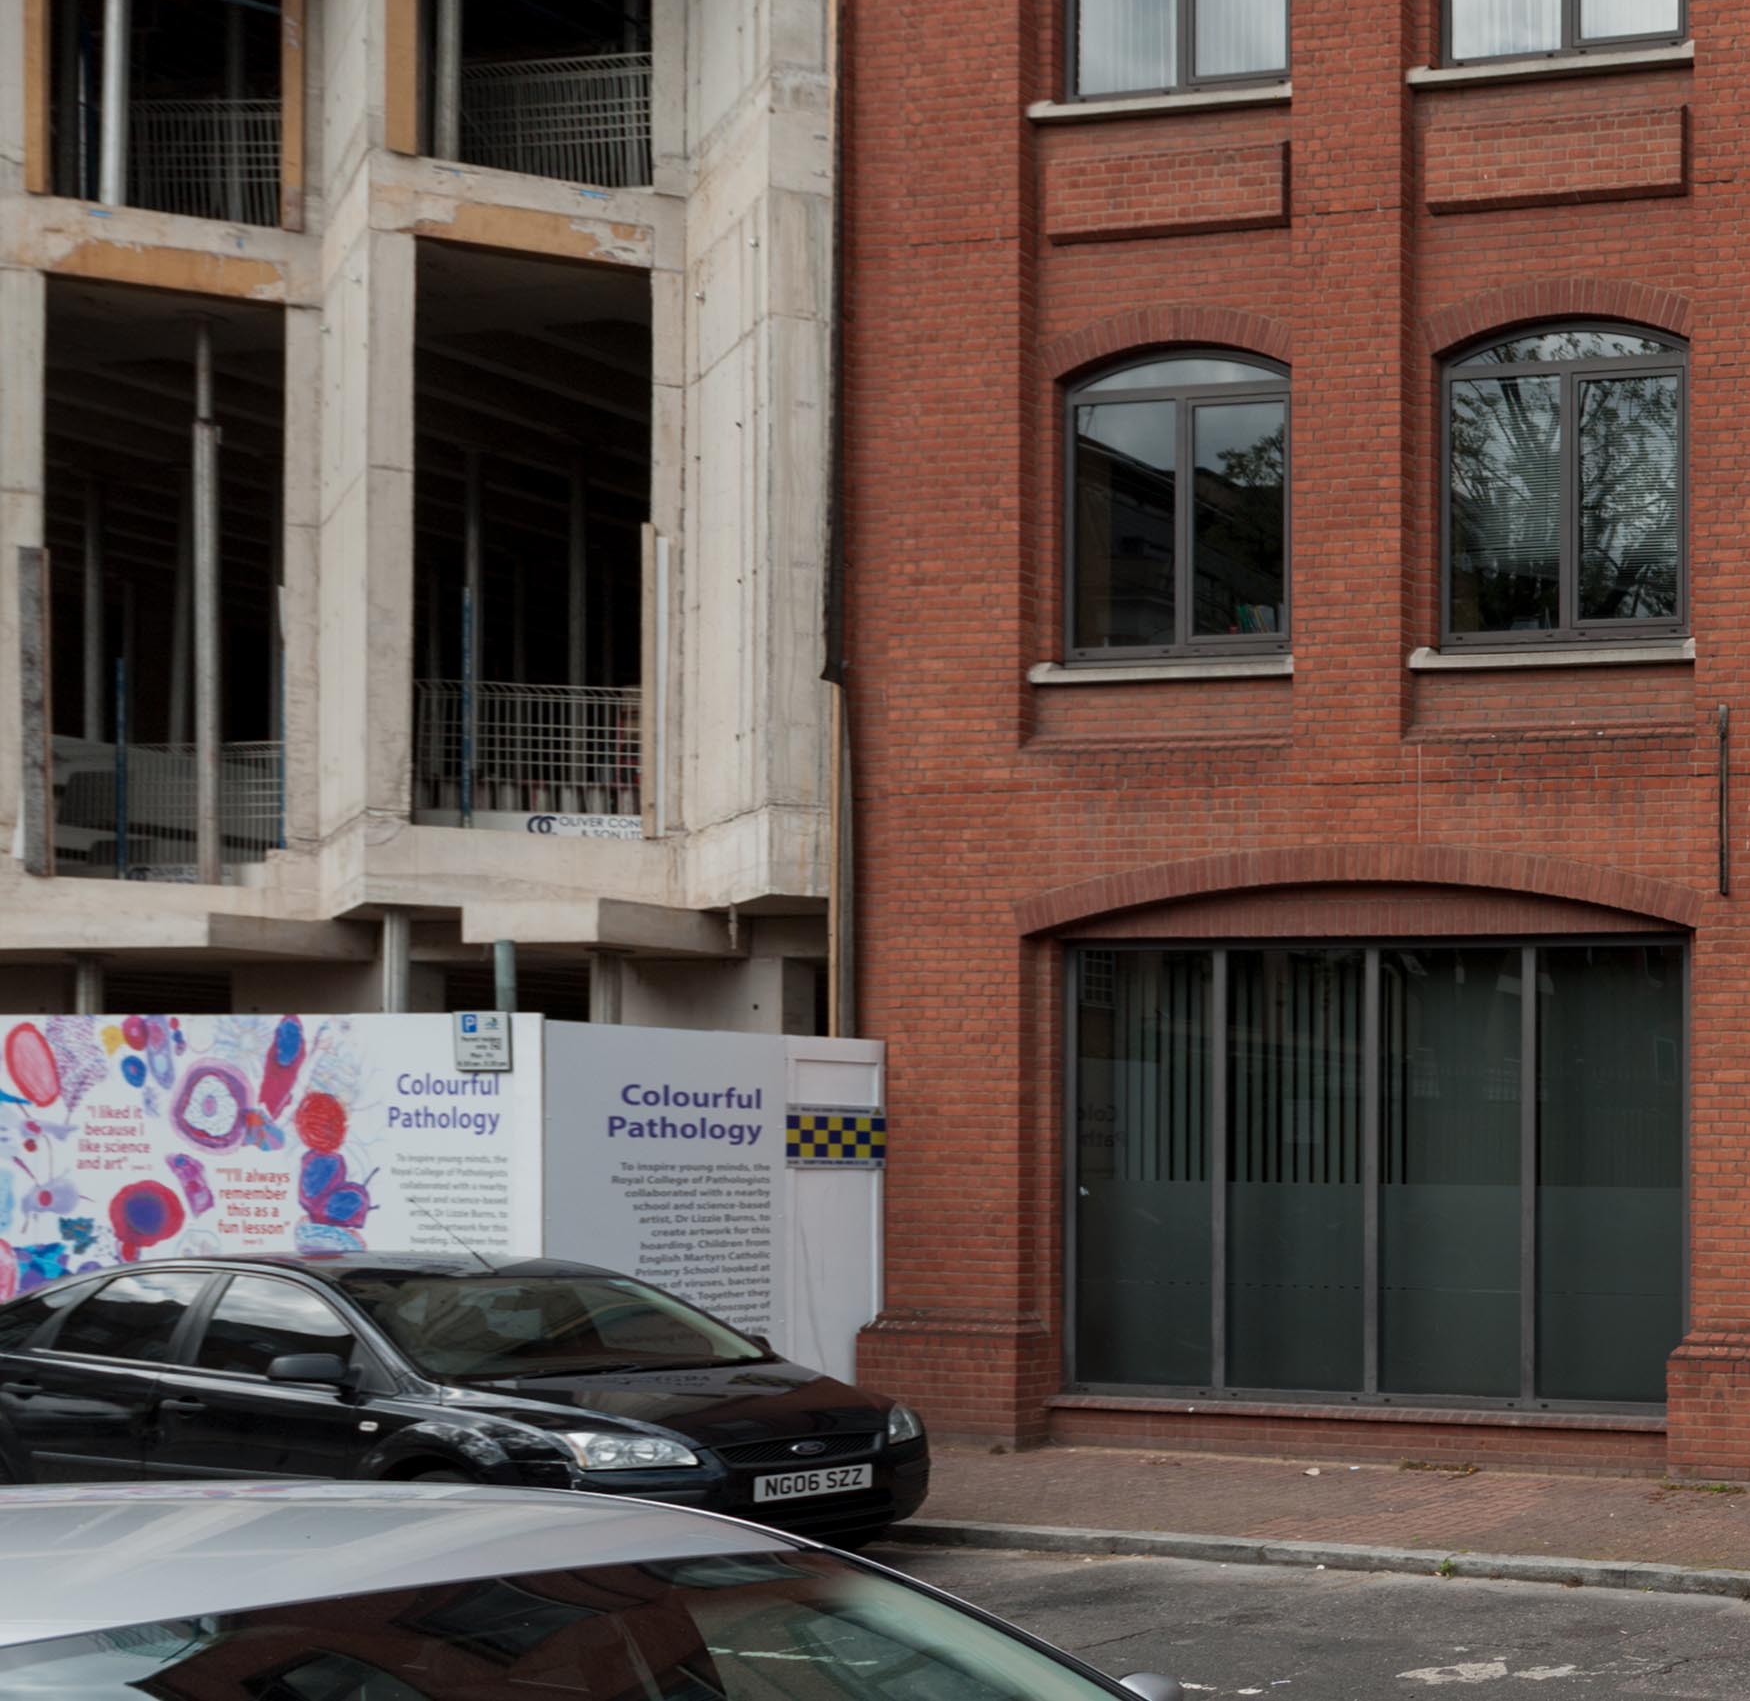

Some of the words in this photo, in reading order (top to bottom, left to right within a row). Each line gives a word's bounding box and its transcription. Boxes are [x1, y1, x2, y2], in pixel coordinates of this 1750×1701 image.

[559, 816, 605, 828] OLIVER
[397, 1072, 500, 1096] Colourful
[621, 1084, 763, 1110] Colourful
[99, 1105, 130, 1119] liked
[133, 1105, 143, 1119] it
[388, 1105, 500, 1135] Pathology
[84, 1123, 135, 1136] because
[607, 1115, 763, 1146] Pathology
[78, 1139, 101, 1152] like
[103, 1139, 152, 1153] science
[76, 1157, 101, 1170] and
[245, 1168, 291, 1184] always
[219, 1186, 288, 1200] remember
[227, 1203, 251, 1216] this
[255, 1206, 269, 1217] as
[217, 1220, 239, 1234] fun
[765, 1473, 820, 1497] NG06
[826, 1467, 863, 1489] SZZ
